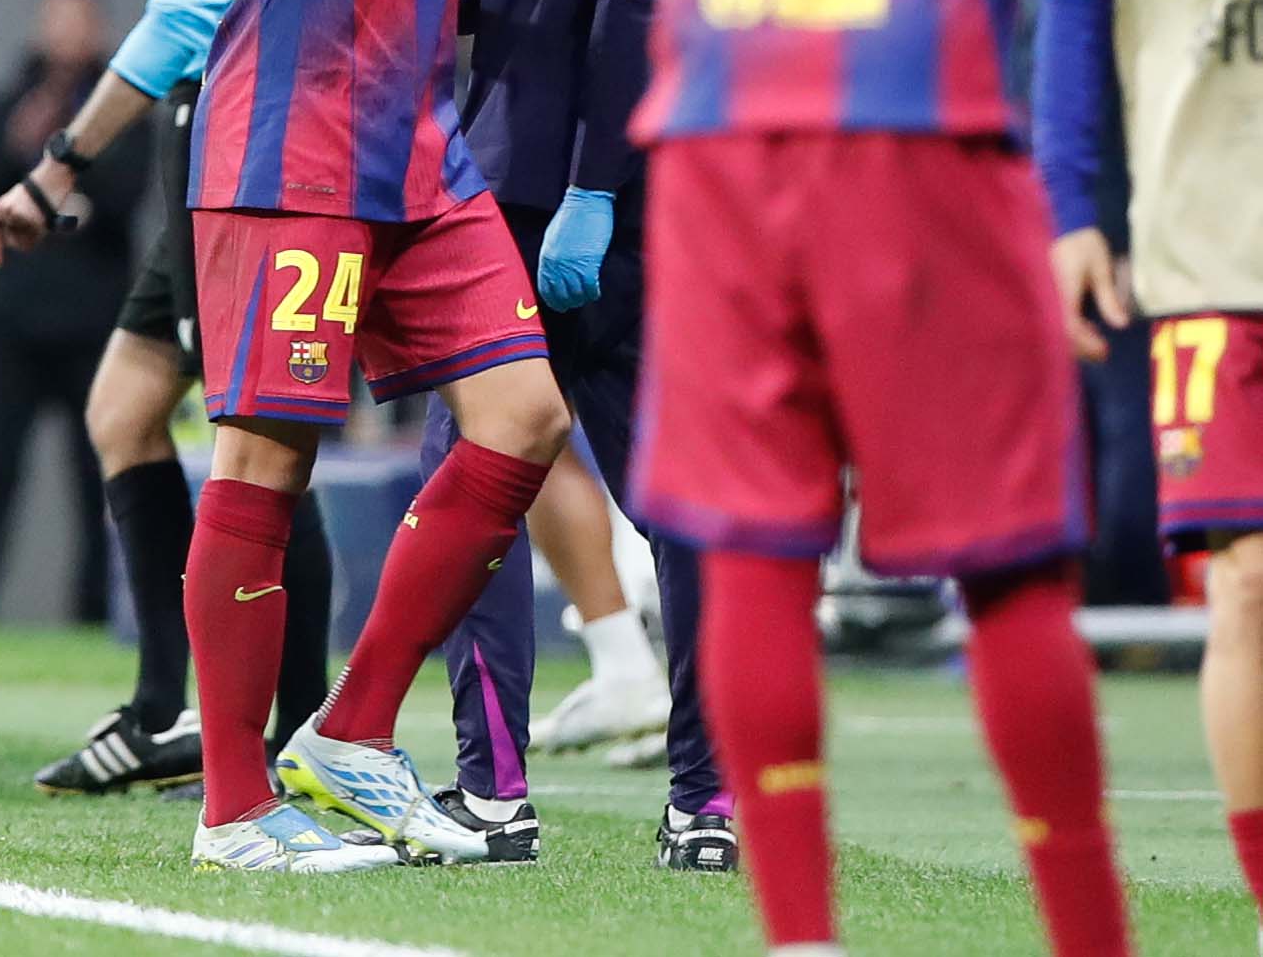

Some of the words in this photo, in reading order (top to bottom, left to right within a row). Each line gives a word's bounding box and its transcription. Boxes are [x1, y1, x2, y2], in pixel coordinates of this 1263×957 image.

[271, 249, 364, 334] 24
[1150, 317, 1228, 426] 17
[698, 847, 724, 860] NIKE
